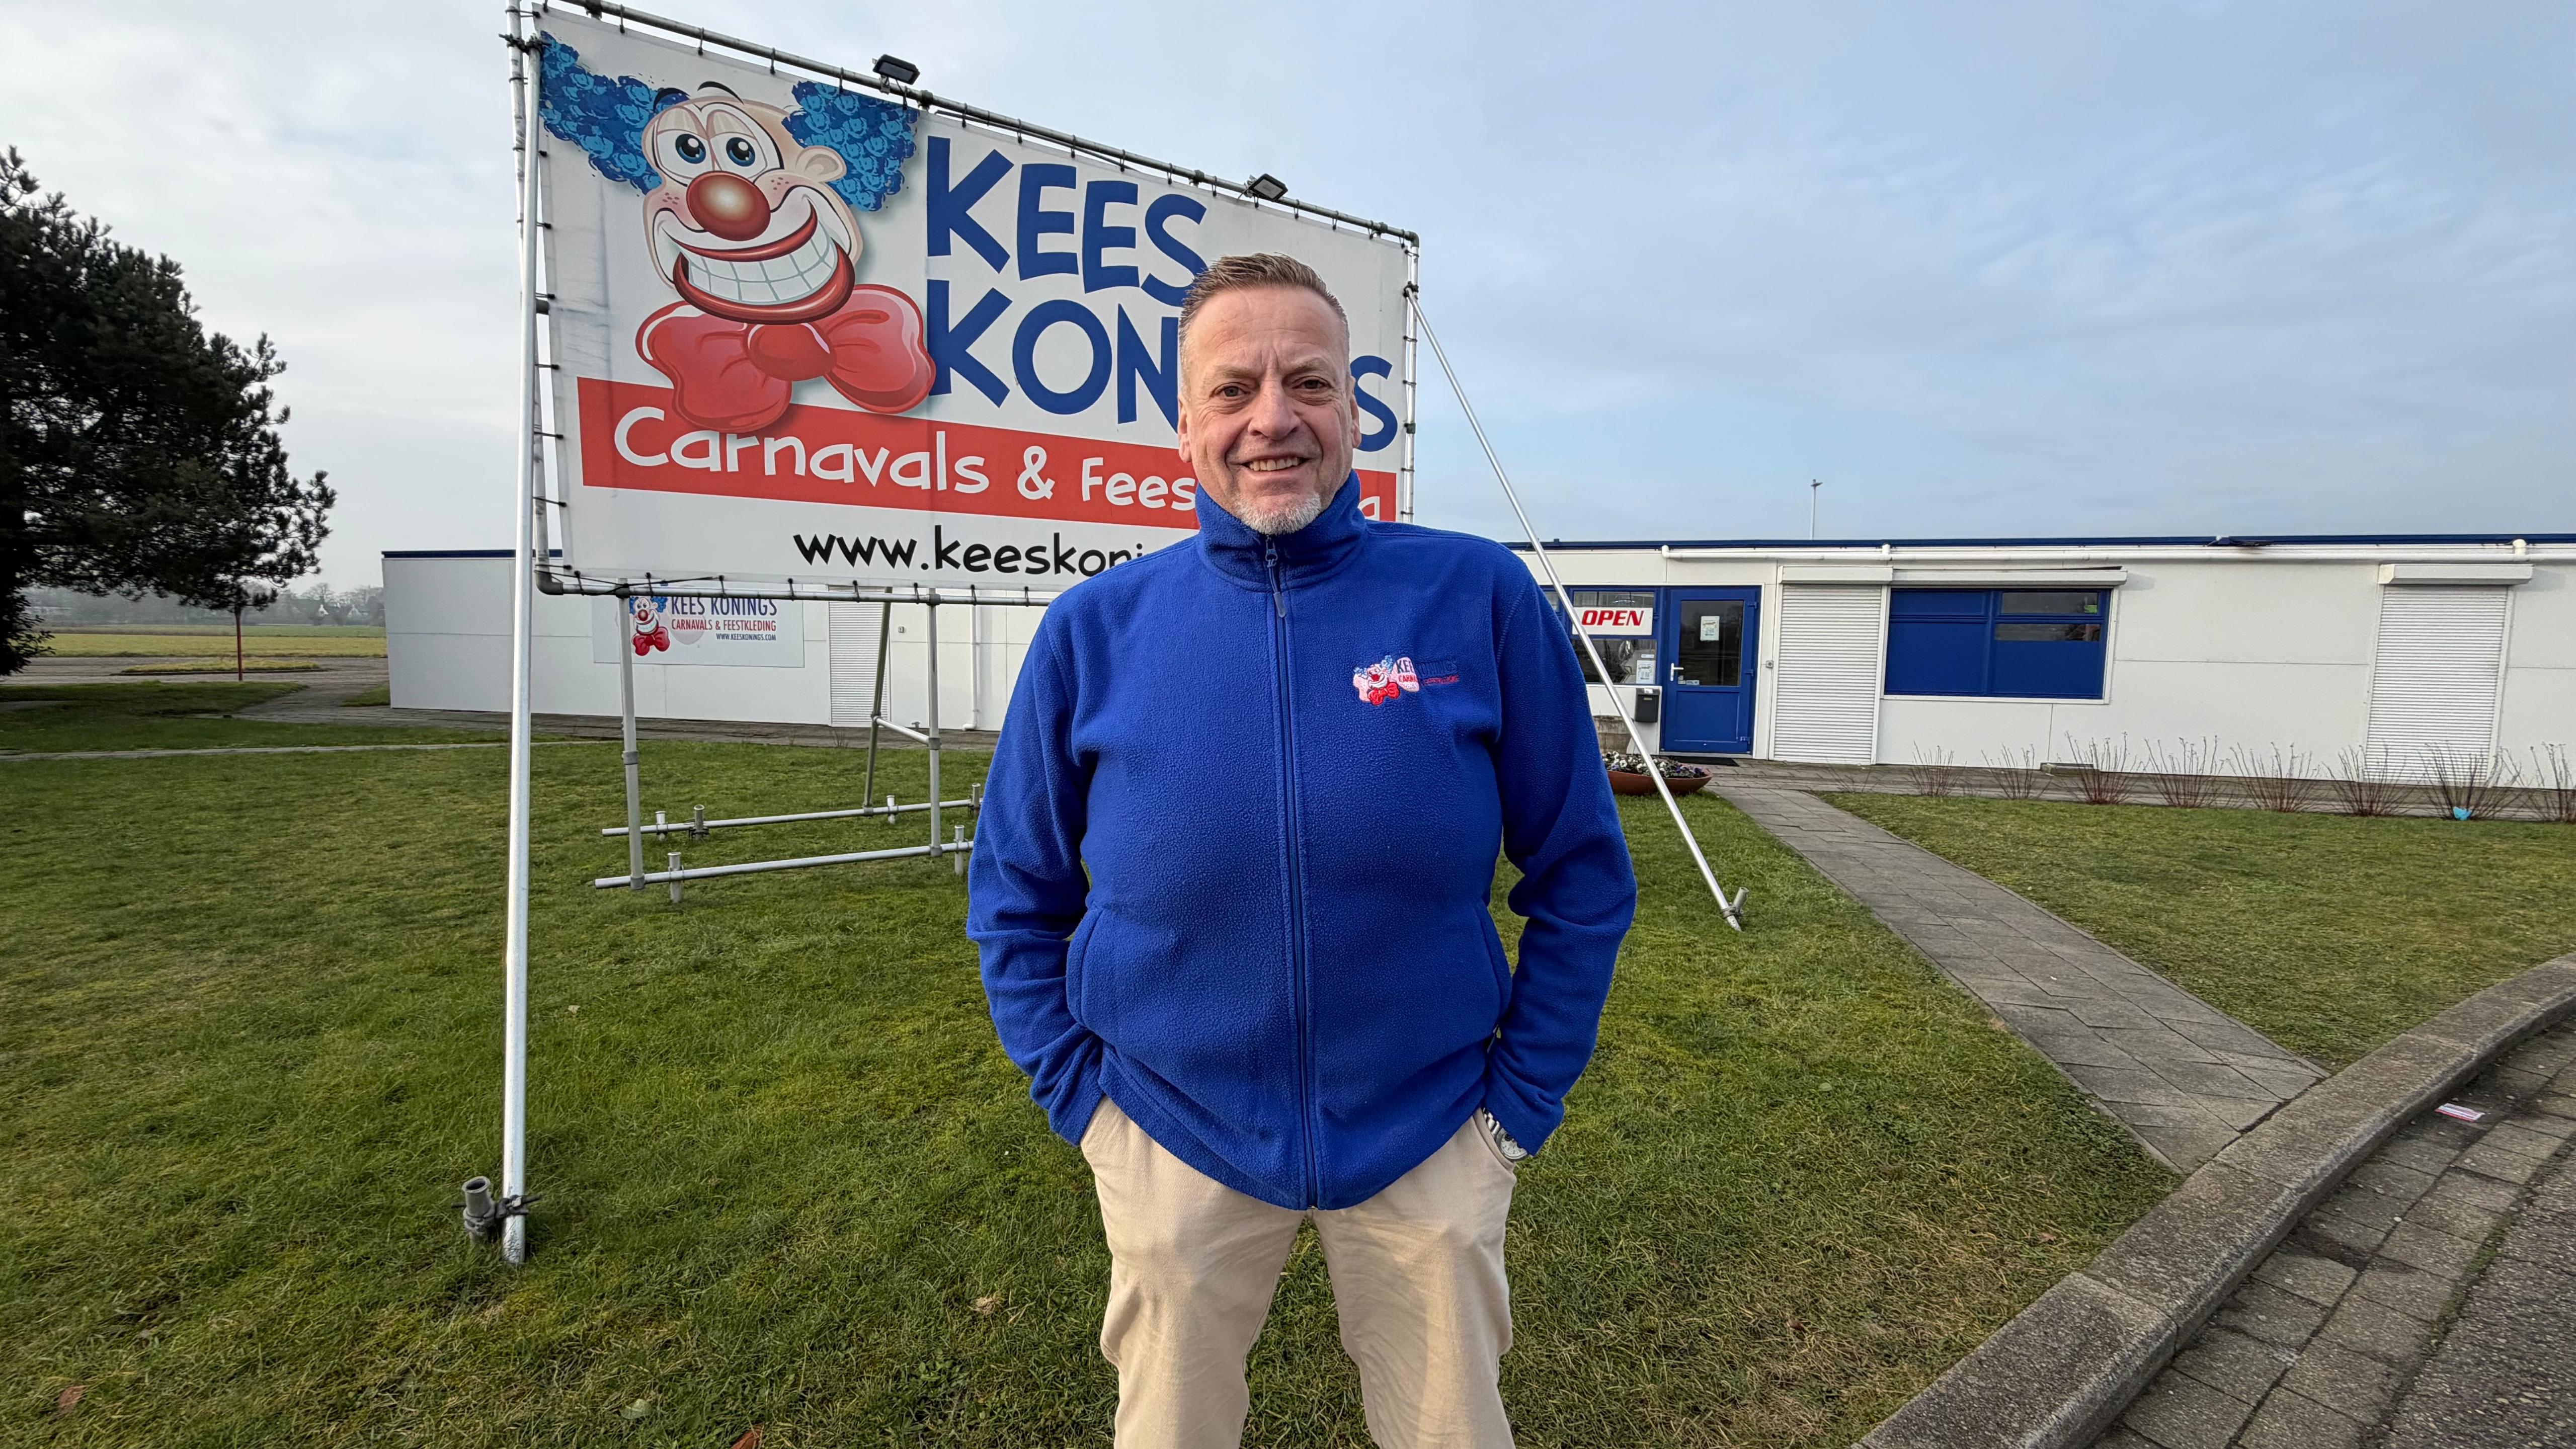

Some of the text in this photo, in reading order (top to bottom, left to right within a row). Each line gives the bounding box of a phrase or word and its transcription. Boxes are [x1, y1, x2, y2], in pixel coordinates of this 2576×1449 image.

[927, 136, 1207, 307] KEES
[928, 279, 1397, 452] KONS
[613, 406, 989, 496] Carnavals
[1017, 445, 1056, 502] &
[671, 597, 777, 616] KEES KONINGS
[671, 619, 776, 631] CARNAVALS & FEESTKLEDING
[1581, 610, 1644, 626] OPEN
[716, 632, 776, 641] WWW.KEESKONINGS.COM
[1396, 659, 1414, 674] KEE
